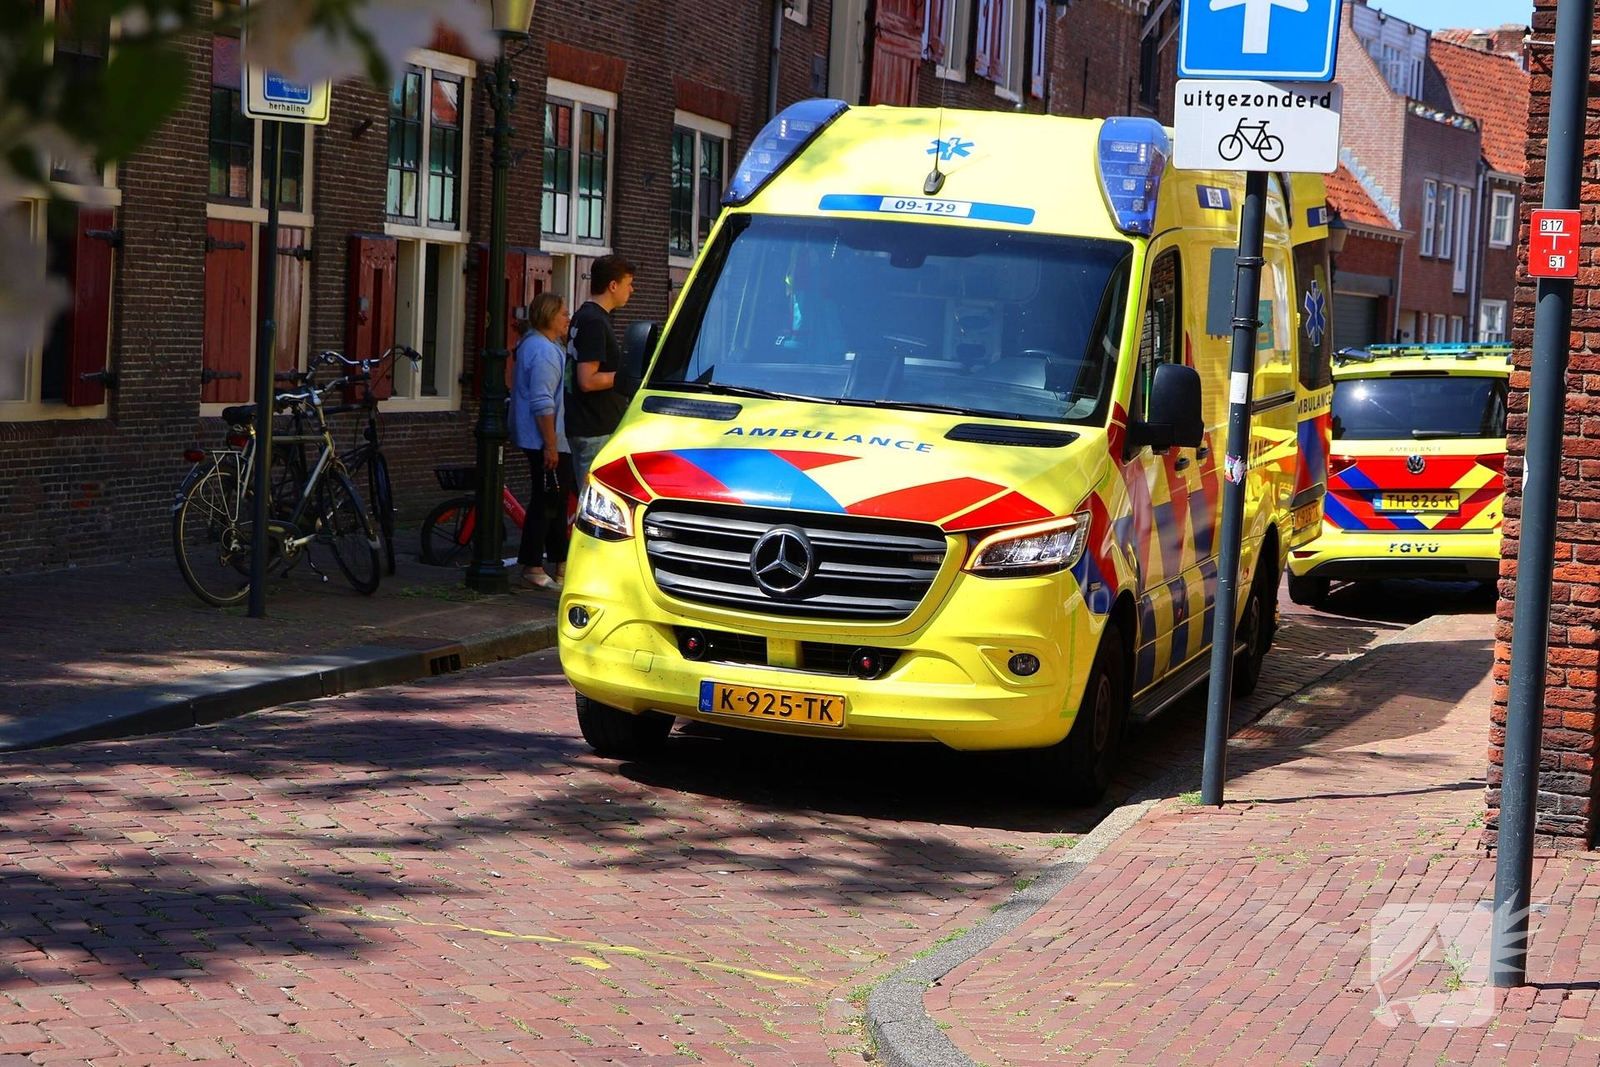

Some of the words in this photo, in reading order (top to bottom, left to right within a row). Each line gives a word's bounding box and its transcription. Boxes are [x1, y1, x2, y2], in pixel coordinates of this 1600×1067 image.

[269, 102, 305, 114] herhaling
[1184, 90, 1331, 112] uitgezonderd
[894, 200, 956, 213] 09-129
[1541, 220, 1563, 231] B17
[1550, 256, 1563, 267] 51
[1298, 391, 1331, 414] MBULANCE
[724, 427, 934, 453] AMBULANCE
[1387, 494, 1454, 508] TH-826-K
[721, 688, 834, 721] K-925-TK
